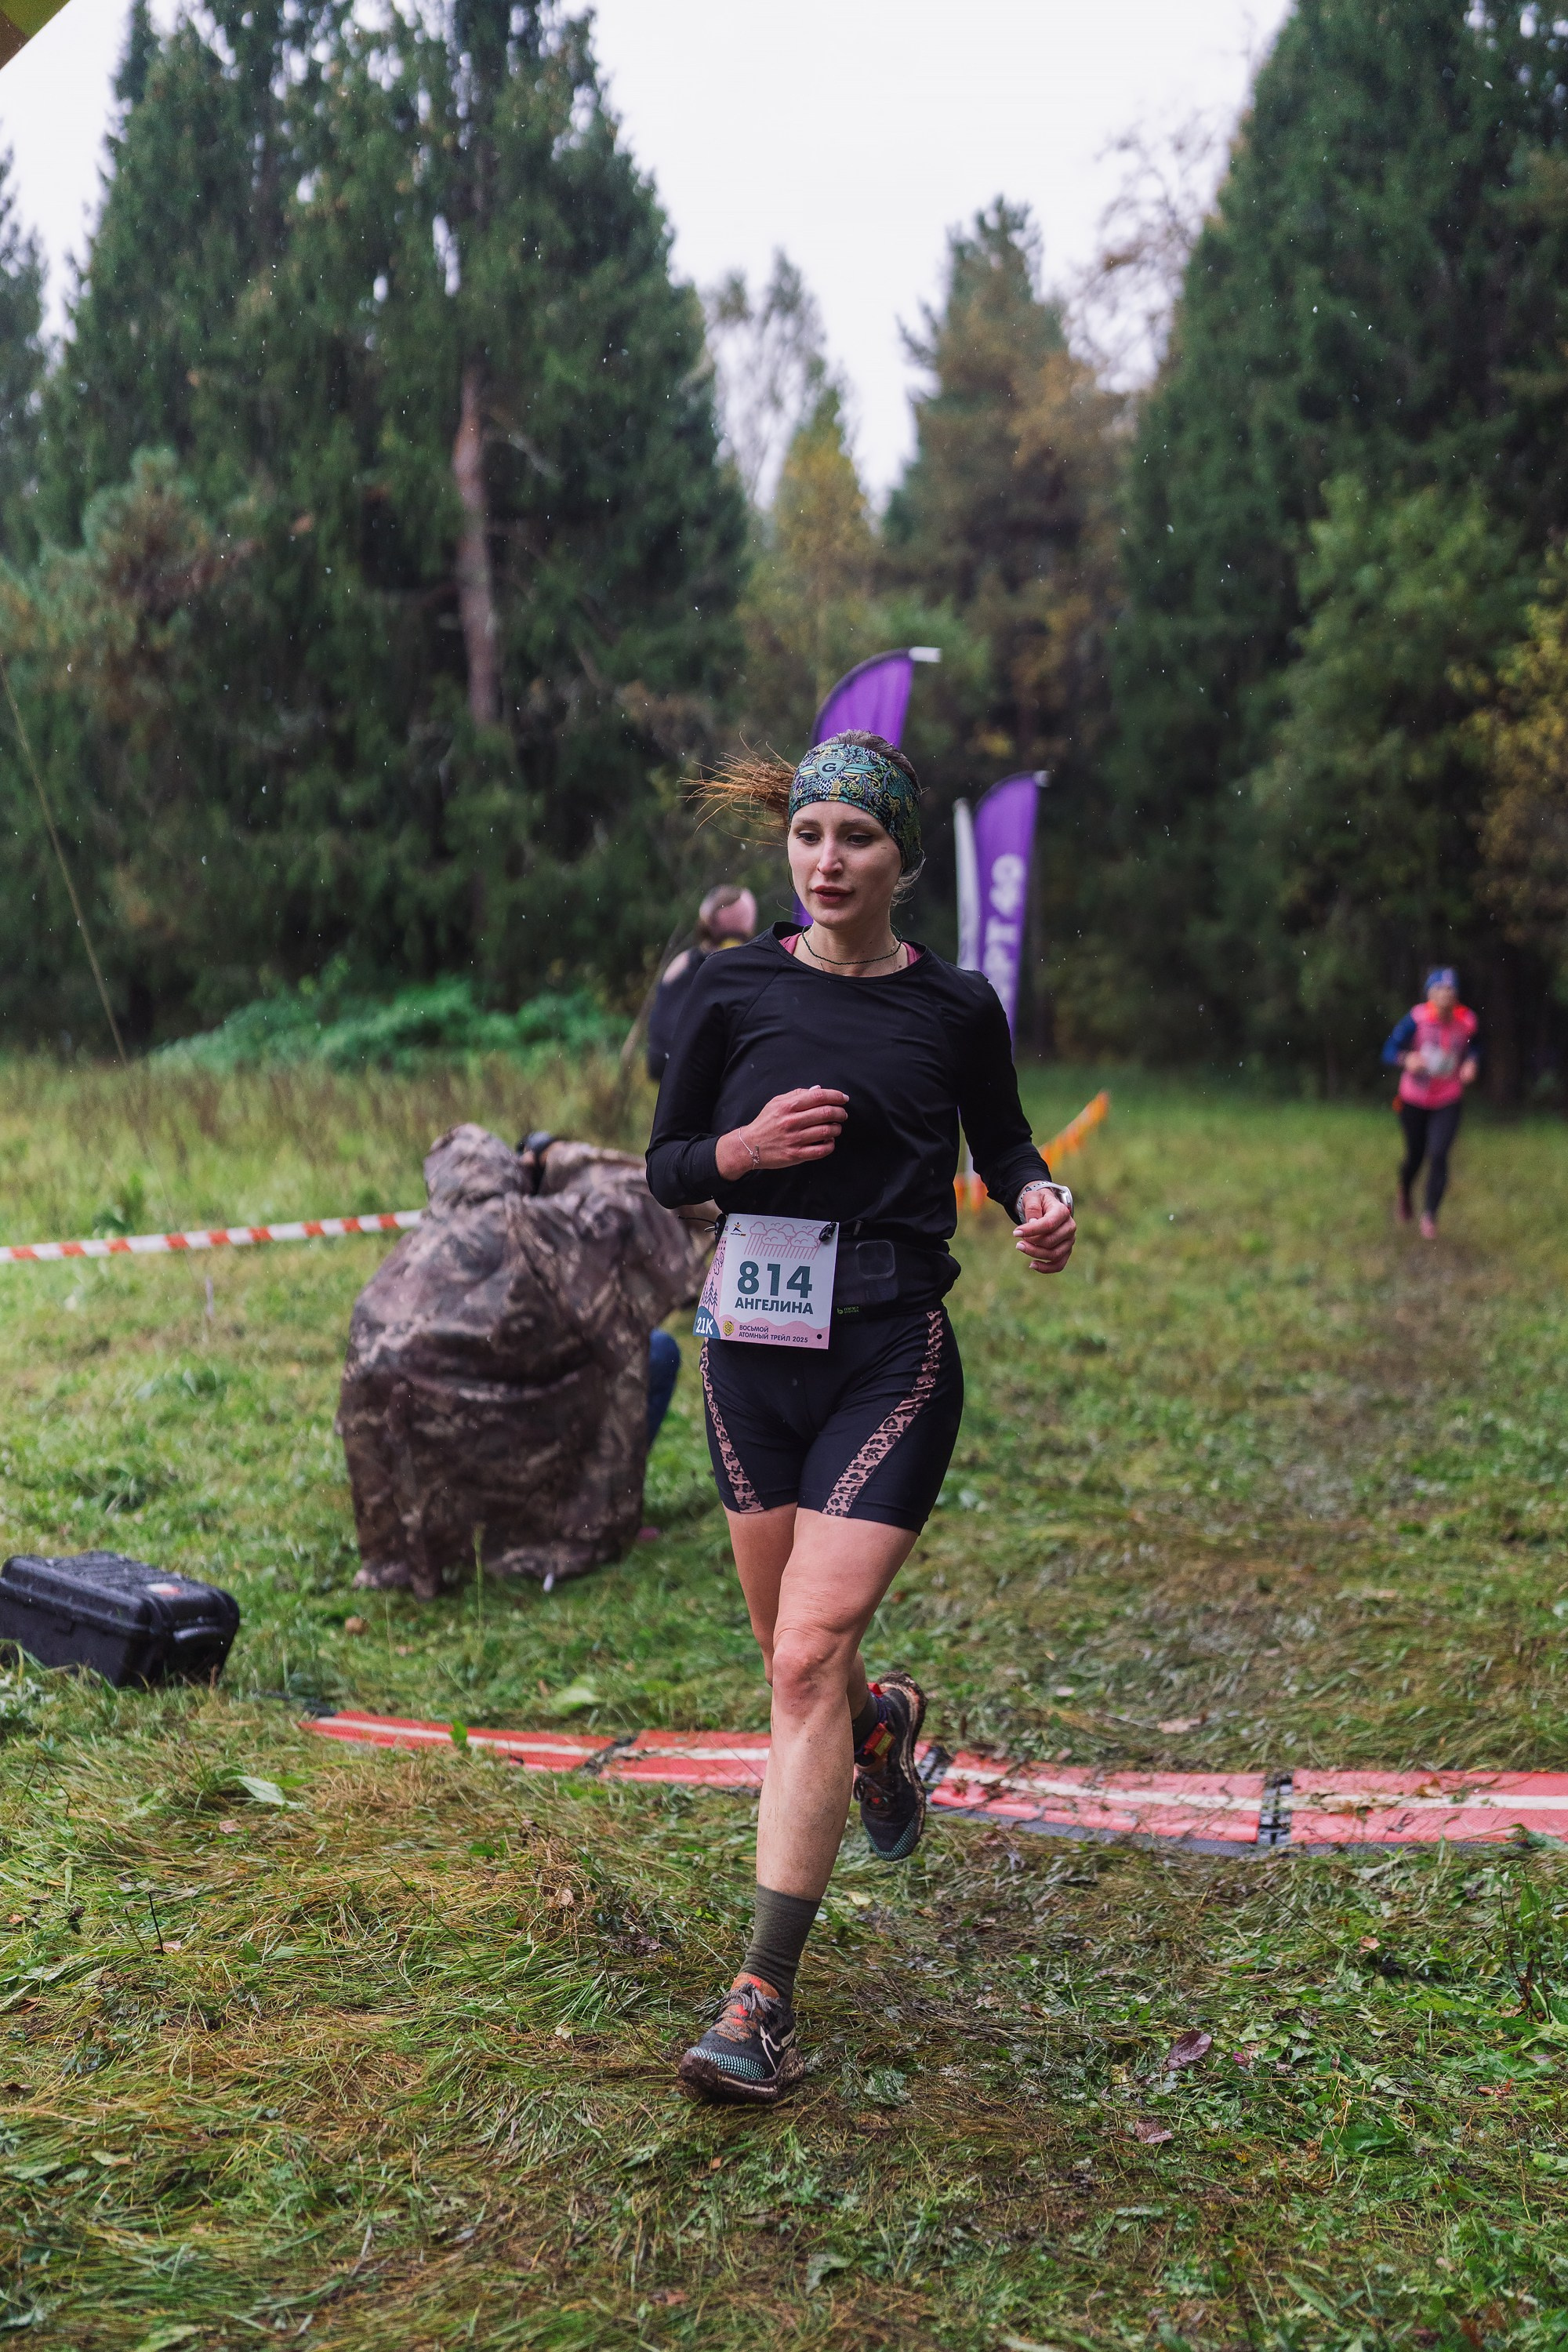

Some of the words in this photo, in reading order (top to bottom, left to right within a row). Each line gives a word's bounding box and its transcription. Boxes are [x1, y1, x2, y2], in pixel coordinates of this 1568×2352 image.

[822, 763, 837, 772] G
[737, 1261, 813, 1299] 814
[735, 1297, 813, 1315] АНГЕЛИНА
[695, 1316, 713, 1335] 21K
[739, 1324, 769, 1333] ВОСЬМОЙ
[739, 1331, 769, 1340] АТОМНЫЙ
[771, 1333, 791, 1342] ТРЕЙЛ
